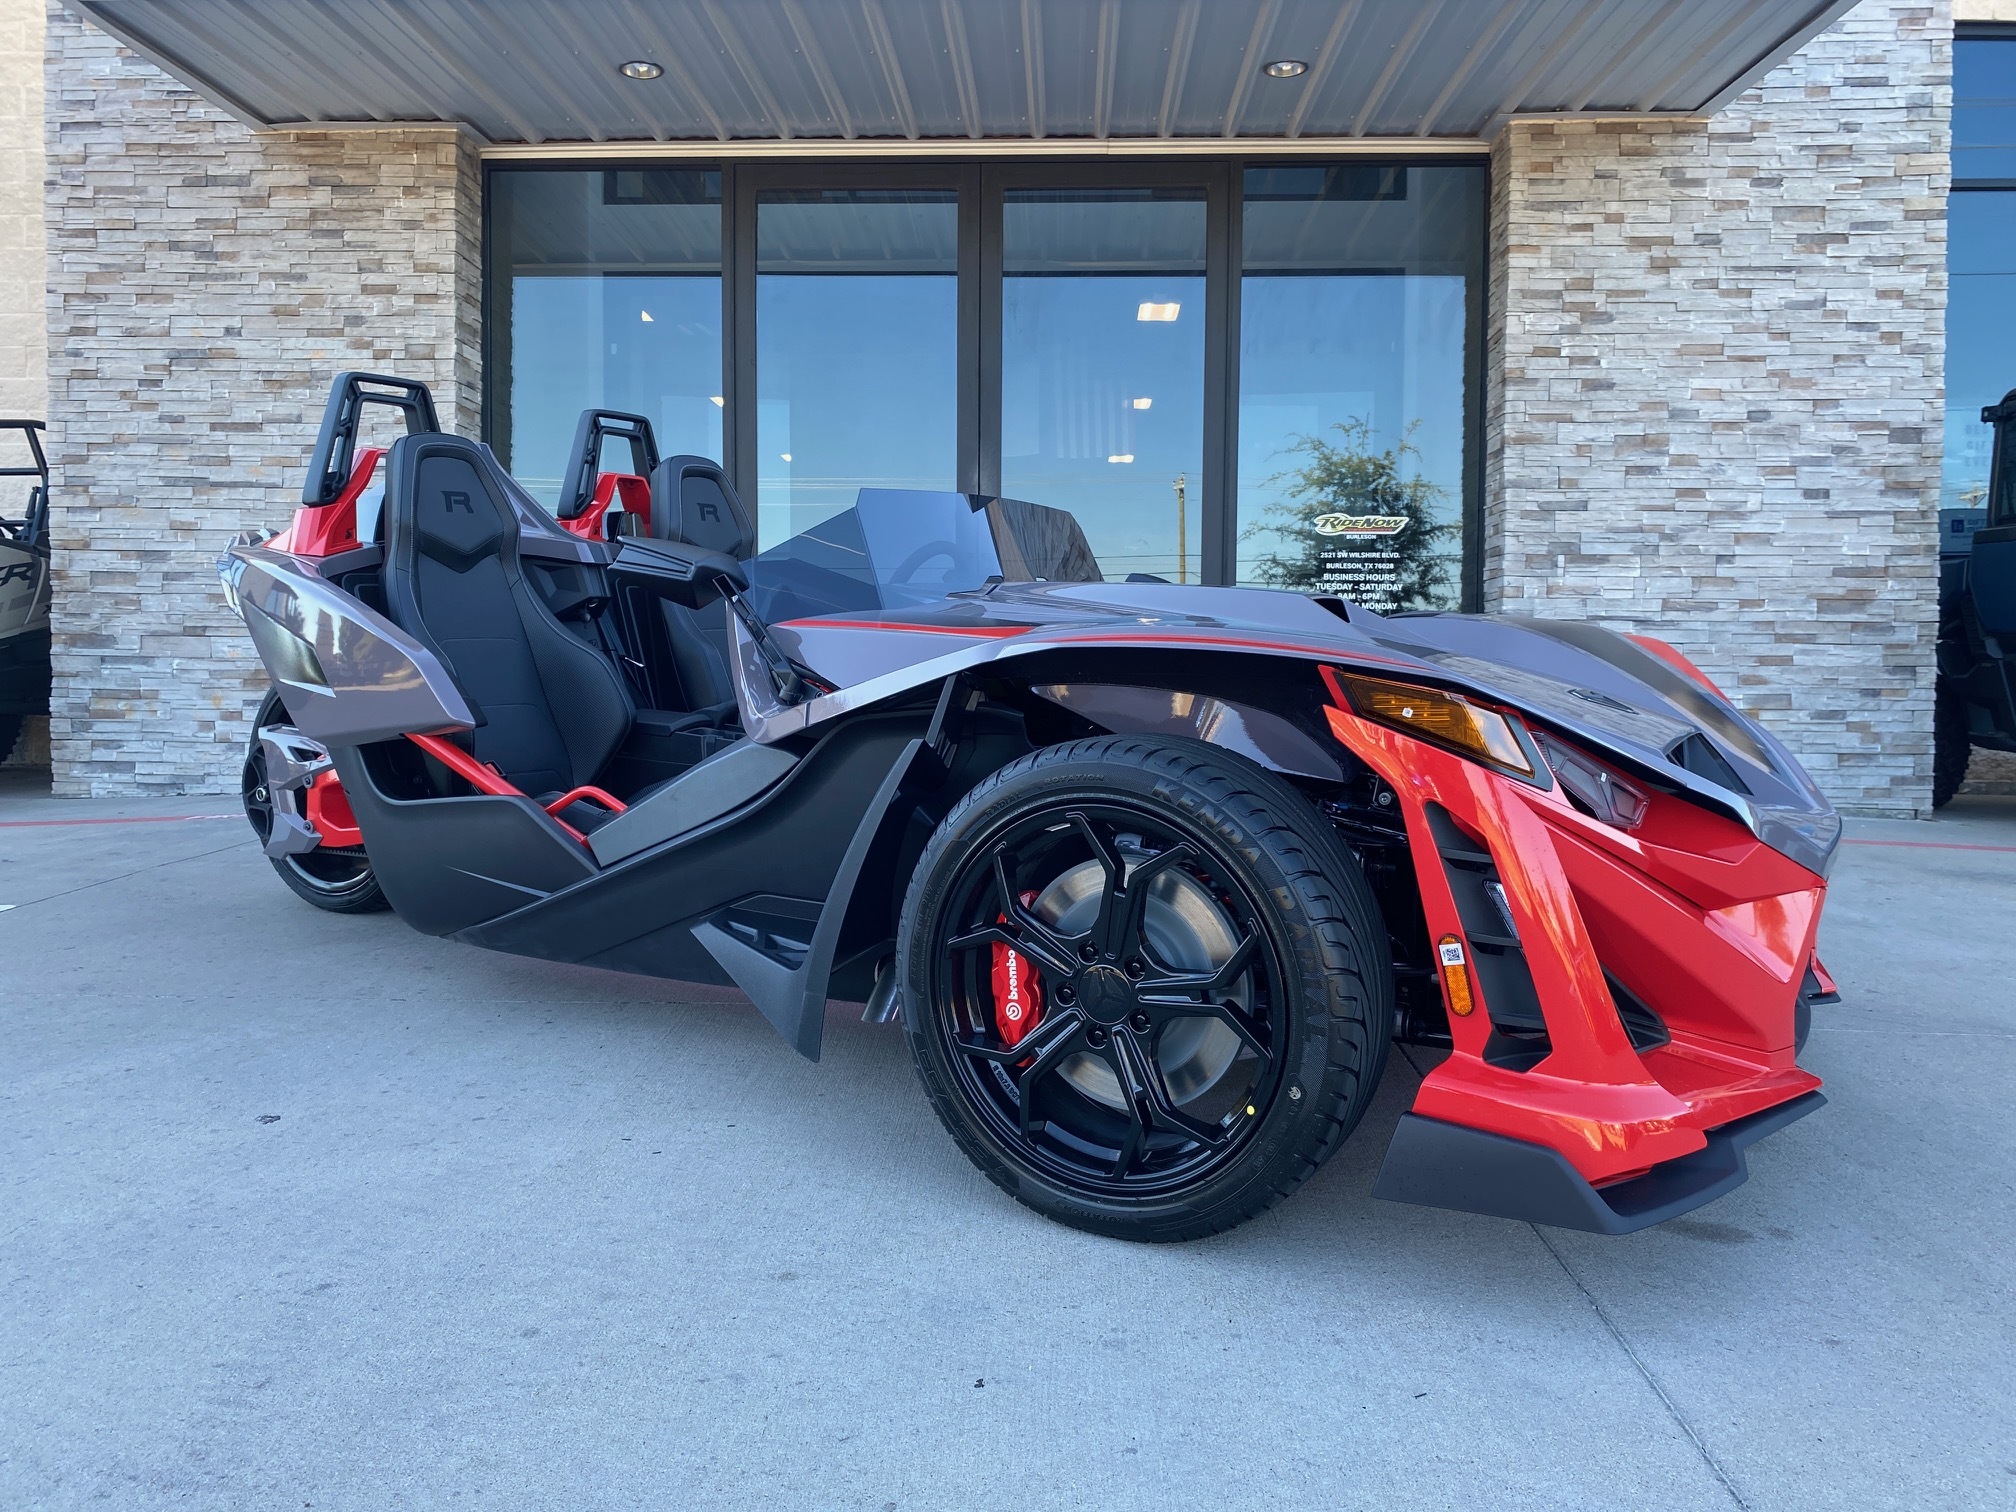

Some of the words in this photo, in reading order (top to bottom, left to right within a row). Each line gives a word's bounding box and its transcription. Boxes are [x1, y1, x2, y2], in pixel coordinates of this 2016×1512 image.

[441, 491, 474, 514] R
[696, 502, 720, 522] R
[1323, 573, 1365, 581] BUSINESS
[1366, 573, 1396, 581] HOURS
[1315, 582, 1353, 590] TUESDAY
[1359, 583, 1403, 591] SATURDAY
[1362, 592, 1380, 600] 6PM
[1361, 602, 1397, 610] MONDAY
[1045, 774, 1104, 786] ROTATION
[985, 792, 1023, 817] RADIAL
[1151, 777, 1261, 865] KENDA
[1006, 949, 1018, 1000] brembo
